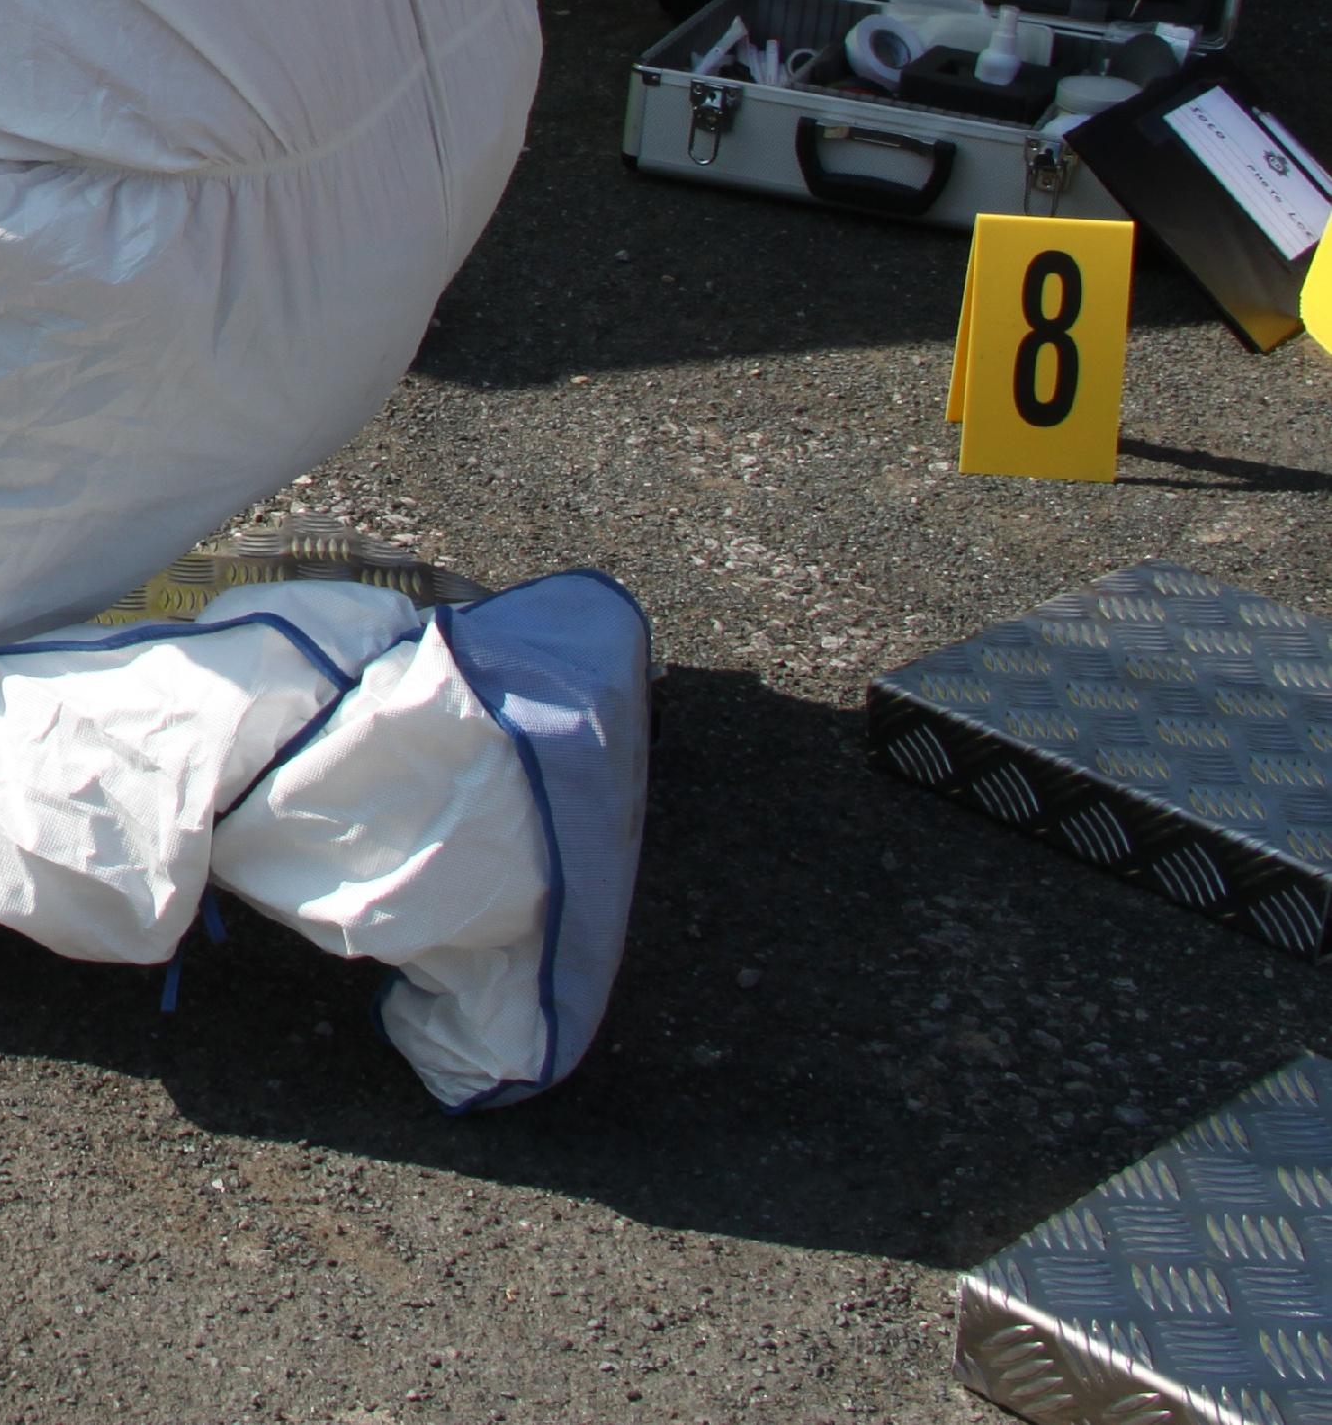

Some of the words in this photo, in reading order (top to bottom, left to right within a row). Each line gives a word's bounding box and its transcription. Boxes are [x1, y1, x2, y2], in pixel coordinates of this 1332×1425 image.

[1191, 107, 1226, 140] SOCO
[1246, 164, 1283, 203] PHOTO
[1013, 250, 1083, 428] 8
